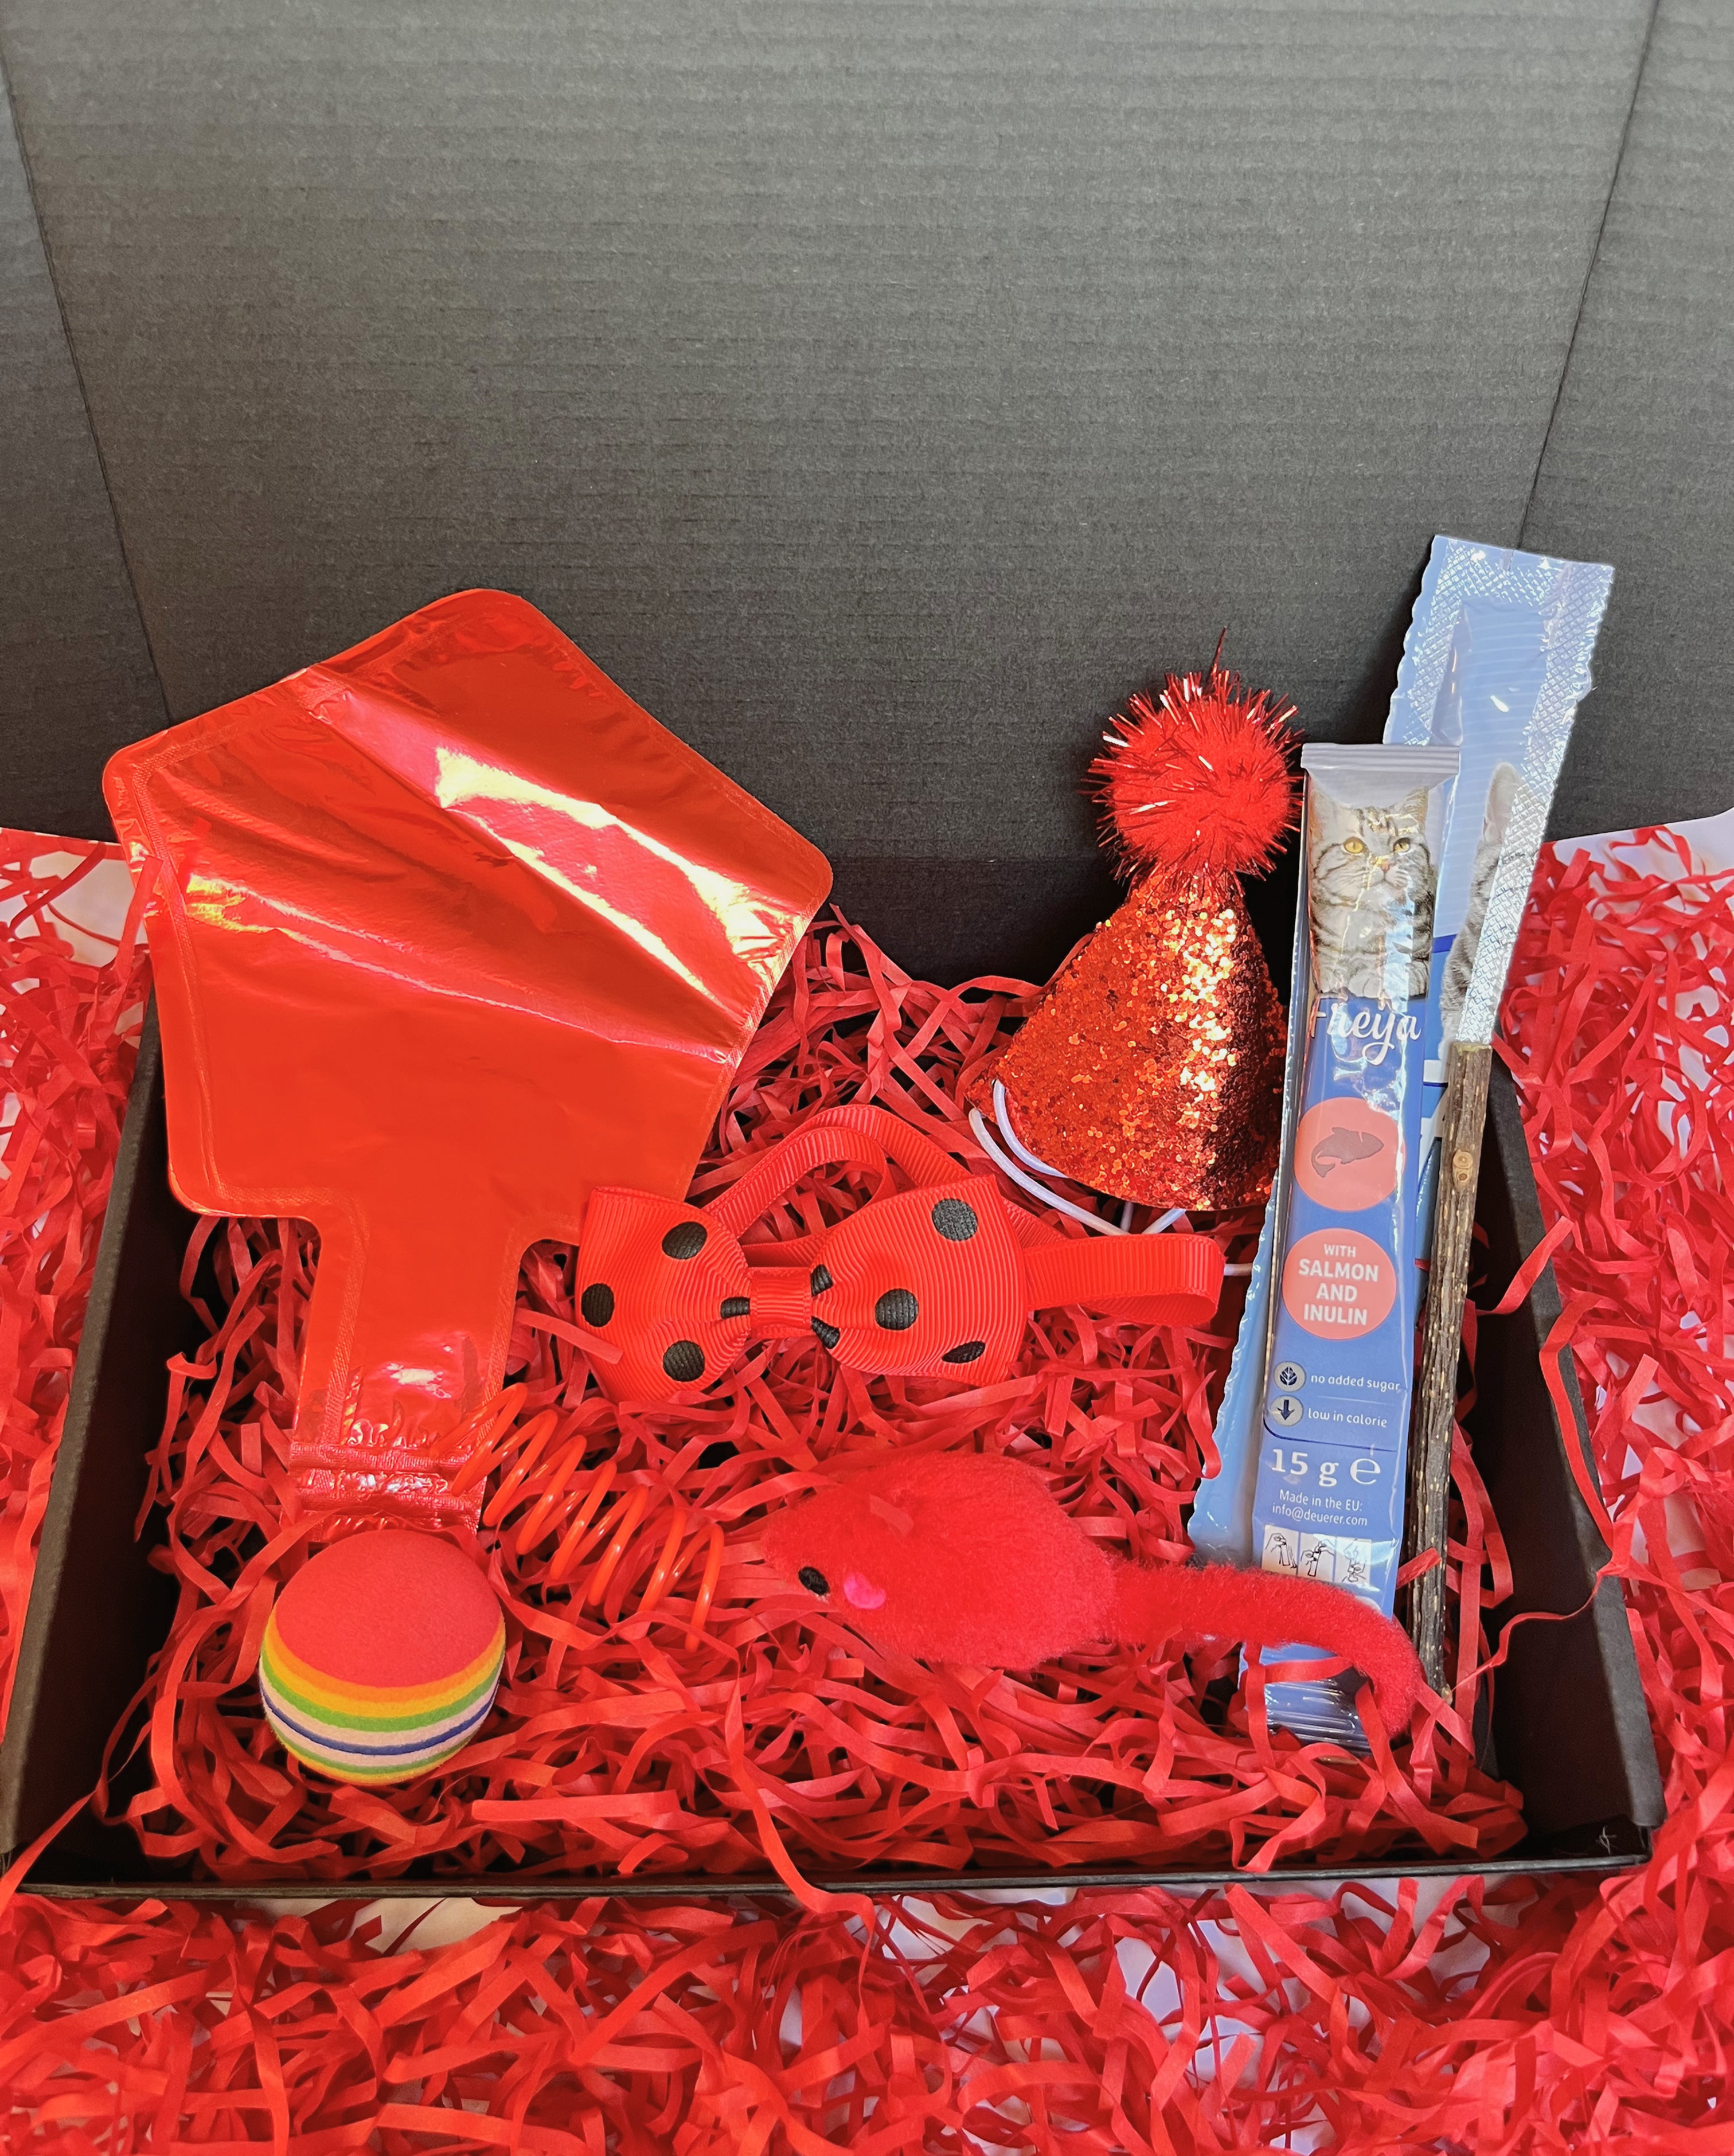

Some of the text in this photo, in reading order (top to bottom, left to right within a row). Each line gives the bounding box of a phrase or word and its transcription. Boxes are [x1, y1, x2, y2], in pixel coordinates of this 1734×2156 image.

[1323, 1243, 1357, 1258] WITH
[1298, 1258, 1379, 1282] SALMON
[1315, 1283, 1358, 1302] AND
[1303, 1303, 1368, 1326] INULIN
[1311, 1375, 1400, 1392] no added sugar
[1307, 1408, 1388, 1427] low in calorie
[1271, 1448, 1309, 1475] 15
[1318, 1462, 1339, 1487] g
[1279, 1489, 1309, 1505] Made
[1311, 1494, 1322, 1507] in
[1325, 1496, 1342, 1510] the
[1272, 1502, 1368, 1526] info@deuerer.com
